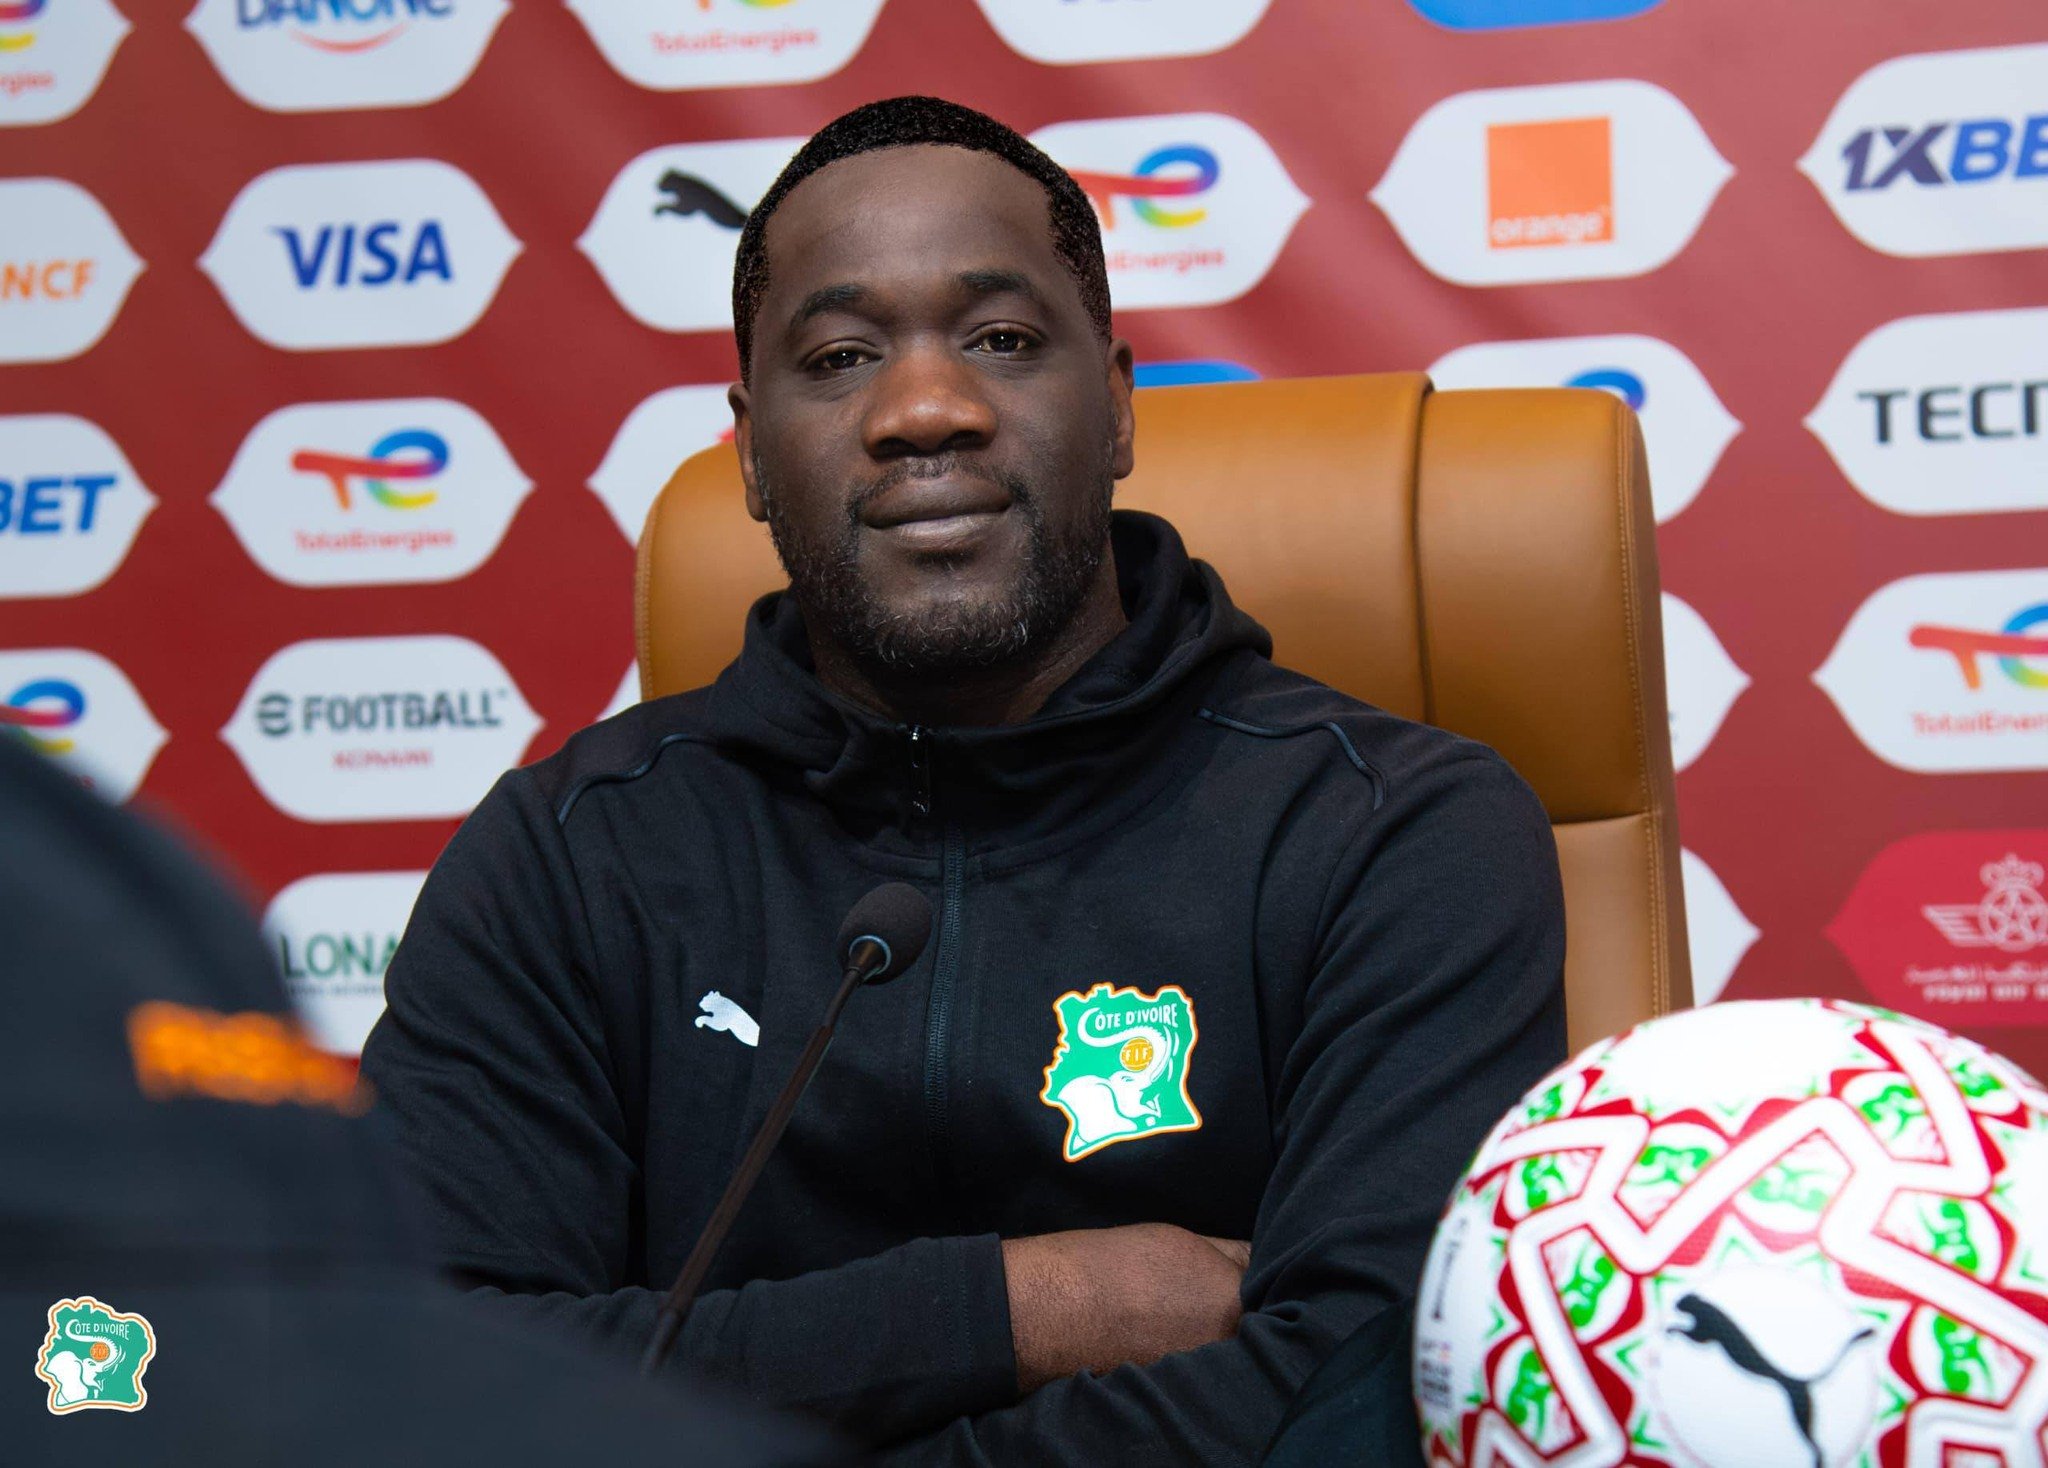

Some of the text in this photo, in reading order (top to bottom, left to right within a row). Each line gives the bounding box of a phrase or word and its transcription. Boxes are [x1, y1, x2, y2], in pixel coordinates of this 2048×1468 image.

[1493, 211, 1604, 244] orange
[270, 220, 453, 288] VISA
[0, 475, 116, 534] ET
[1125, 1003, 1178, 1028] D'IVOIRE
[1124, 1047, 1149, 1062] FIF
